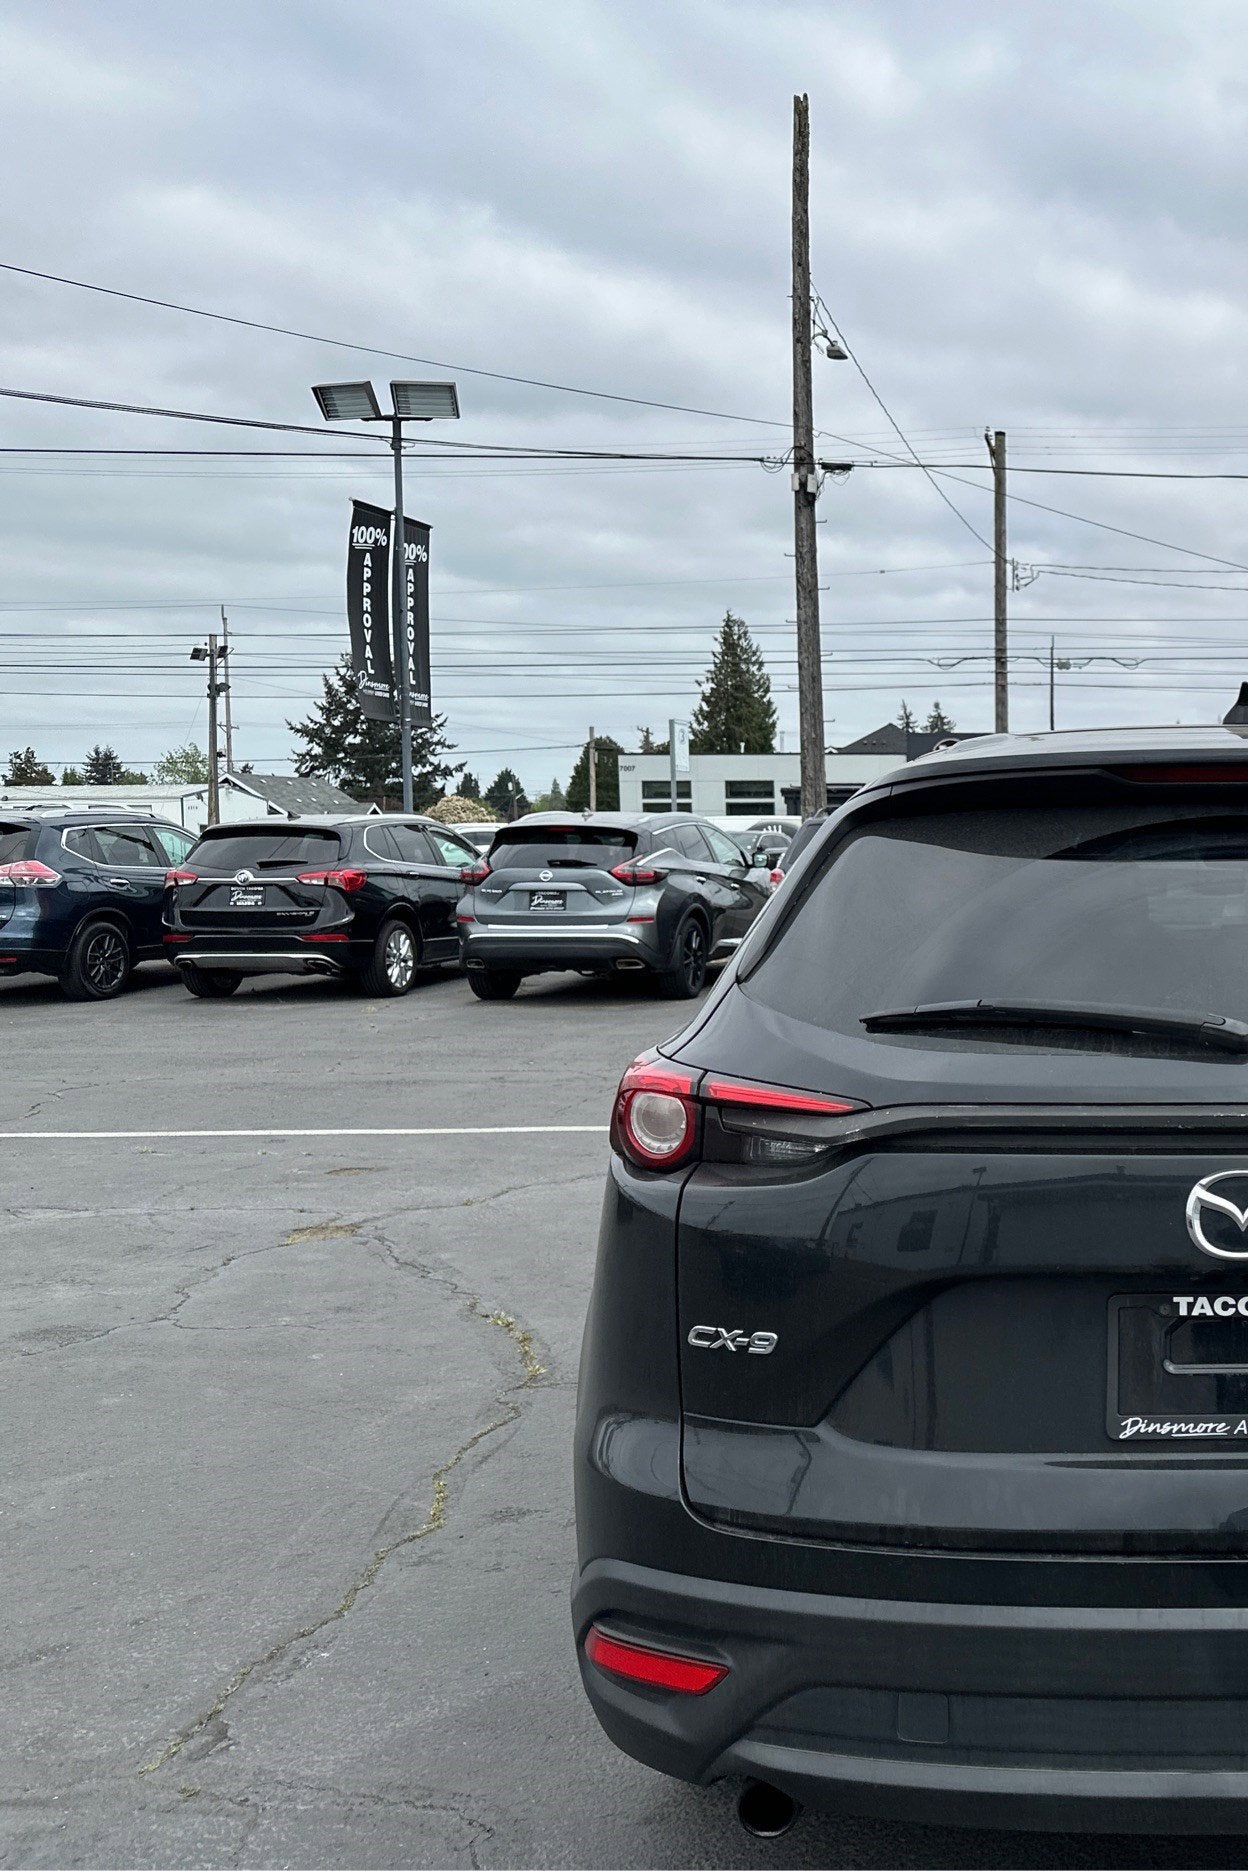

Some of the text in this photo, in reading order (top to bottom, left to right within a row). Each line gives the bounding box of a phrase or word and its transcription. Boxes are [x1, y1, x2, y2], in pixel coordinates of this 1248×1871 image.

[352, 525, 387, 547] 100%
[362, 552, 375, 674] APPROVAL
[406, 568, 416, 685] APPROVAL
[687, 1325, 778, 1354] CX-9
[1118, 1417, 1231, 1439] Dinsmore
